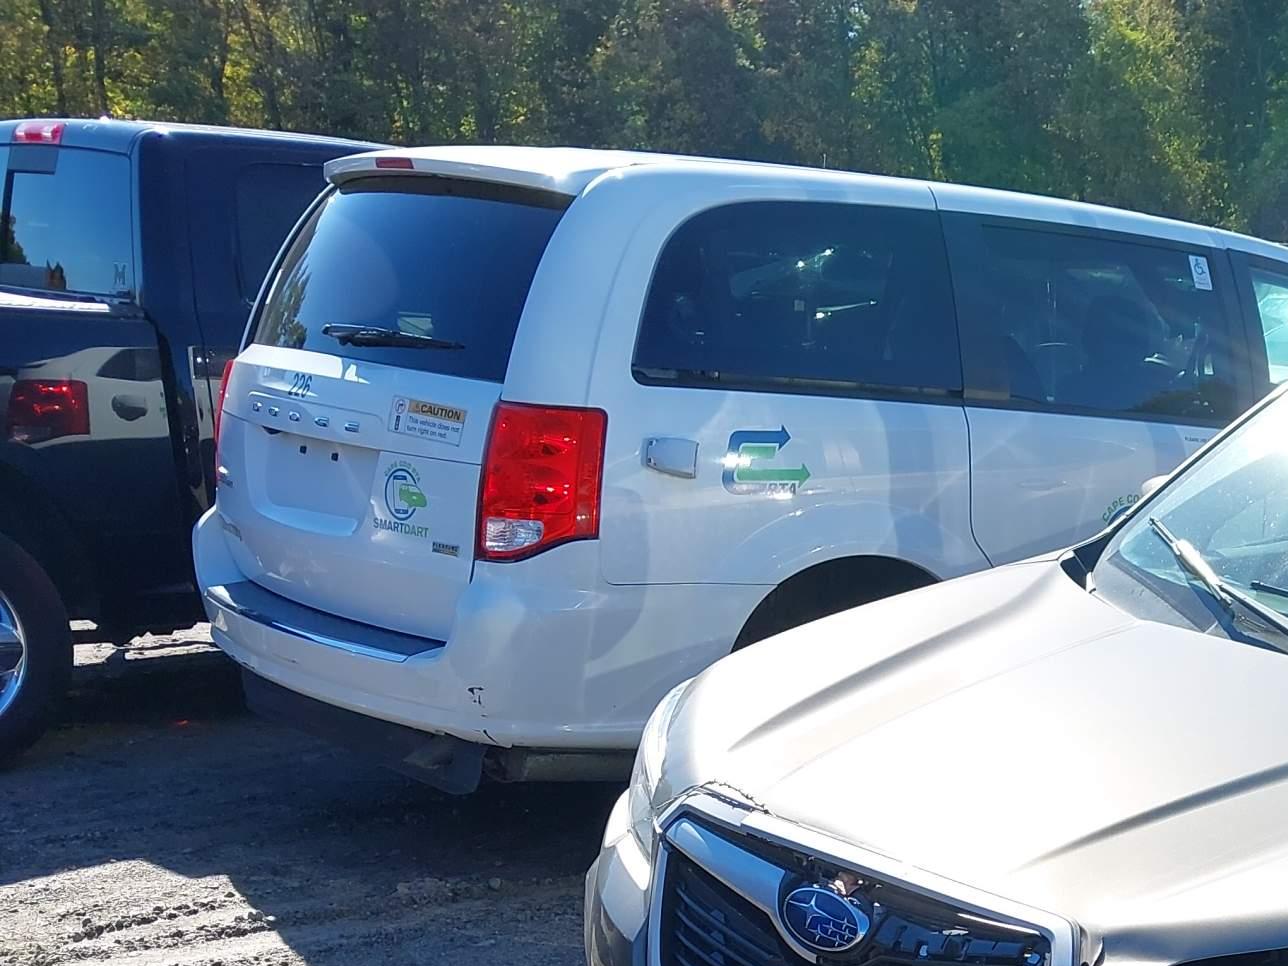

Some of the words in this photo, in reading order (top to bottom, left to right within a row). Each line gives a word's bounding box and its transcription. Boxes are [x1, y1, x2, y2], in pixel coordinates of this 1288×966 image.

[288, 373, 312, 398] 226
[420, 404, 461, 421] CAUTION
[766, 482, 797, 498] RTA
[1102, 497, 1125, 522] CAPE
[1126, 494, 1143, 504] CO
